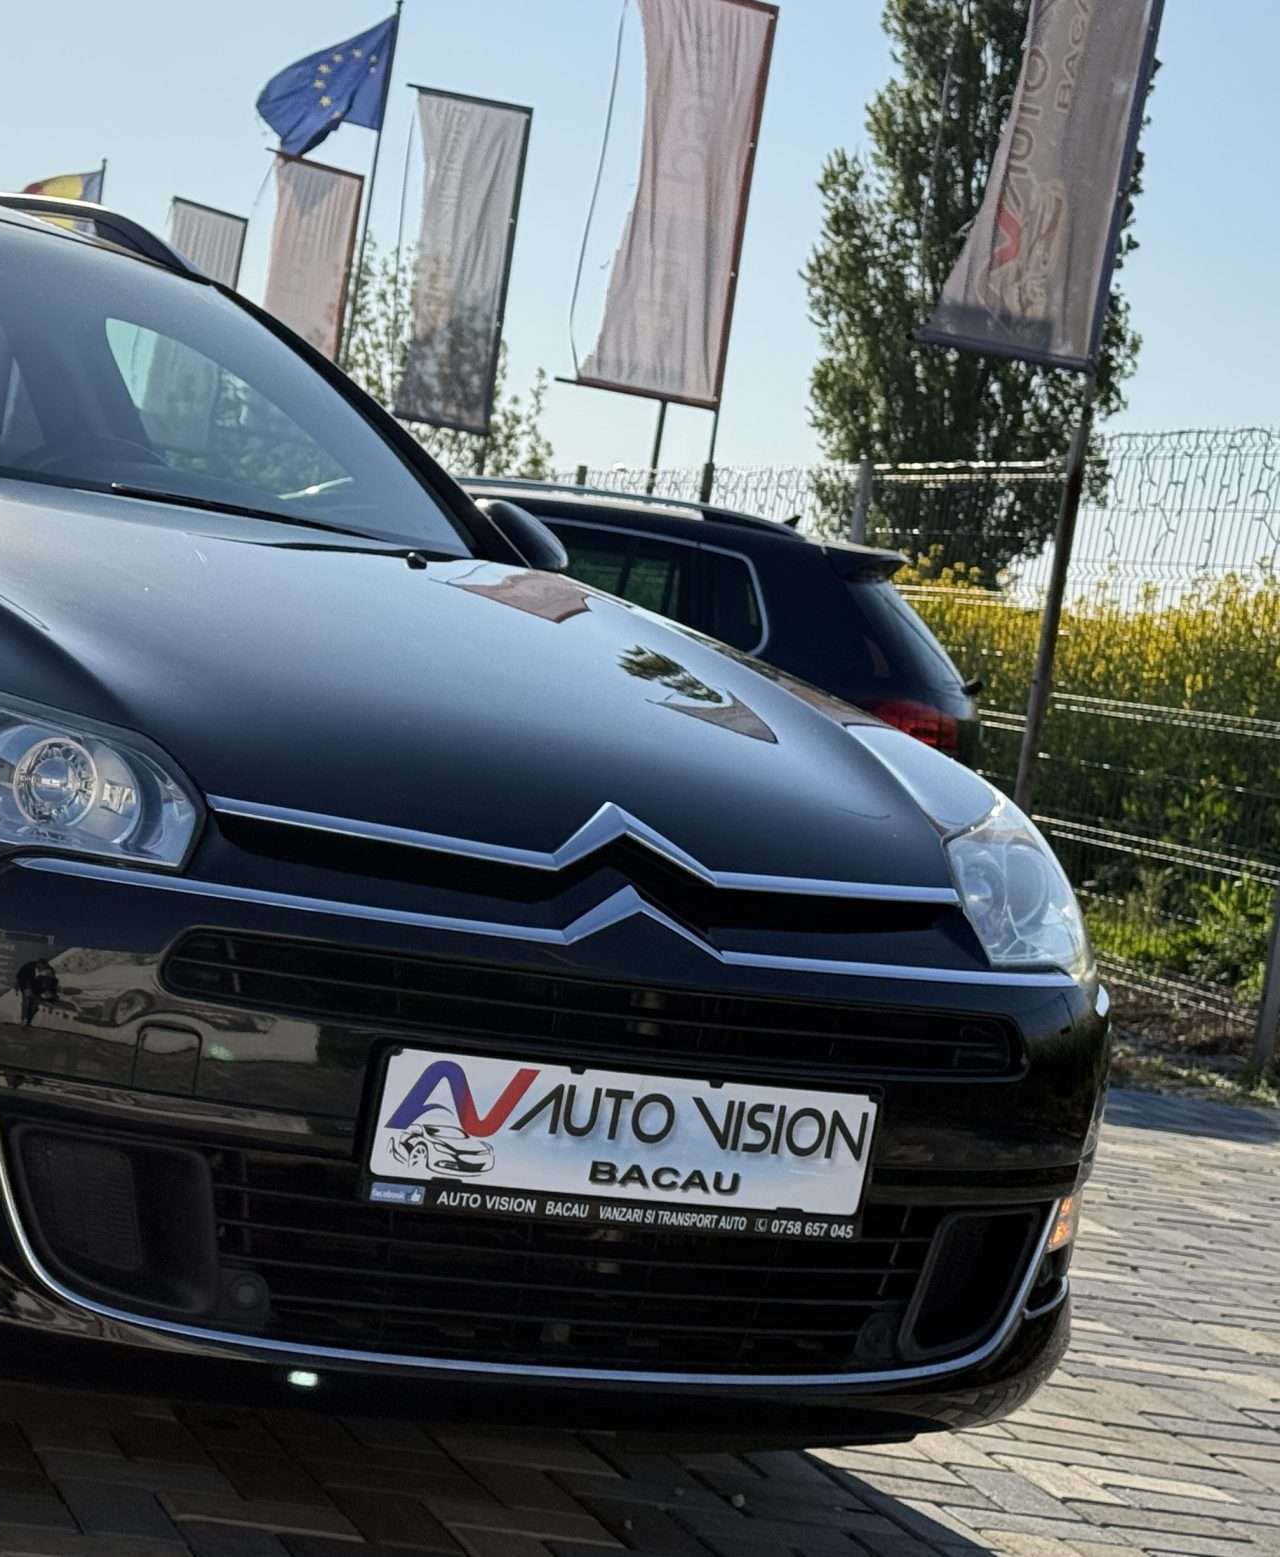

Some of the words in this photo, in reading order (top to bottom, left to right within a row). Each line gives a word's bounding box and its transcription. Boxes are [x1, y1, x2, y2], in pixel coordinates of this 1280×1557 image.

[509, 1084, 676, 1144] AUTO
[692, 1097, 869, 1162] VISION
[588, 1160, 741, 1196] BACAU
[436, 1191, 481, 1209] AUTO
[485, 1195, 536, 1214] VISION
[545, 1201, 590, 1219] BACAU
[599, 1205, 644, 1223] VANZARI
[644, 1210, 657, 1225] SI
[657, 1211, 719, 1230] TRANSPORT
[718, 1216, 747, 1231] AUTO
[771, 1219, 802, 1236] 0758
[804, 1222, 829, 1238] 657
[830, 1225, 855, 1239] 045
